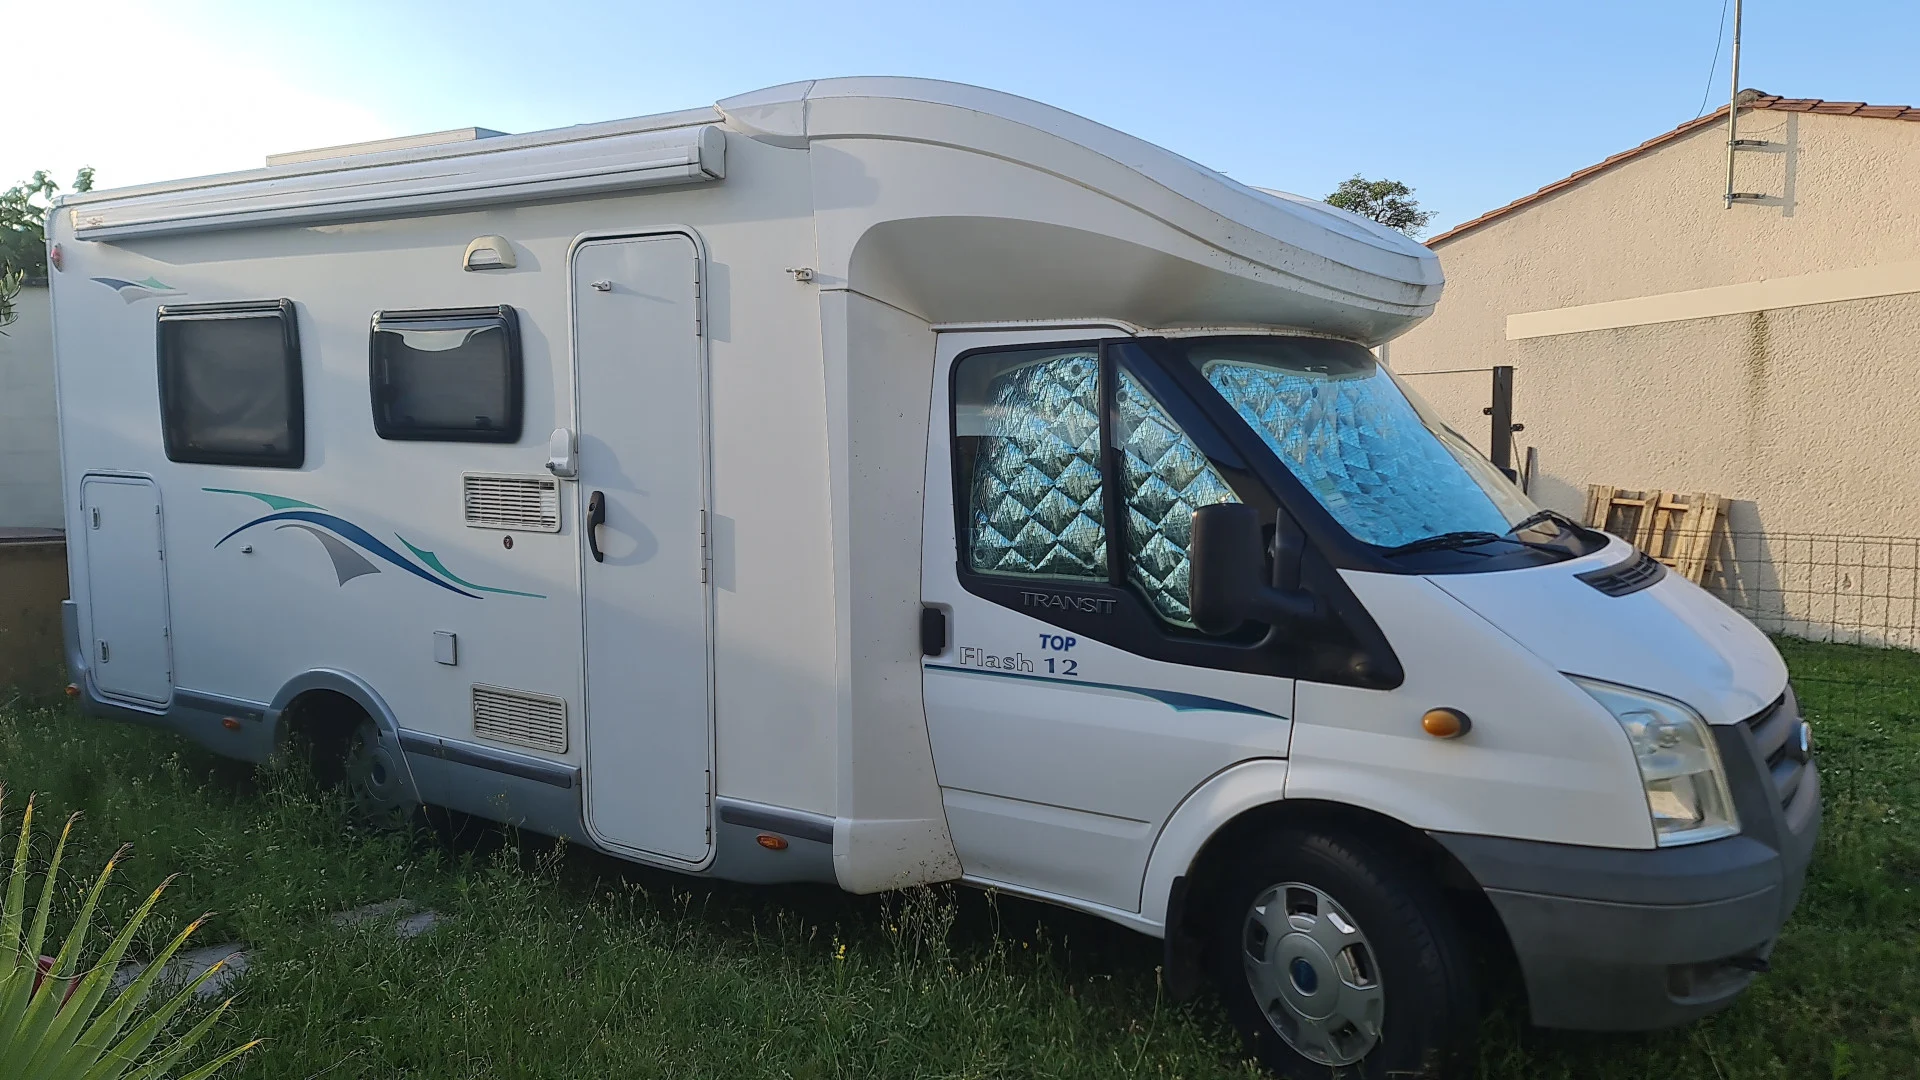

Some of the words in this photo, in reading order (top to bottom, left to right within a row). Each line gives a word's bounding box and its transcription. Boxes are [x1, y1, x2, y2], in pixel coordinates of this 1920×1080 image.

[1020, 591, 1117, 614] TRANSIT
[1039, 633, 1076, 652] TOP
[959, 646, 1034, 673] Flash
[1043, 657, 1078, 676] 12
